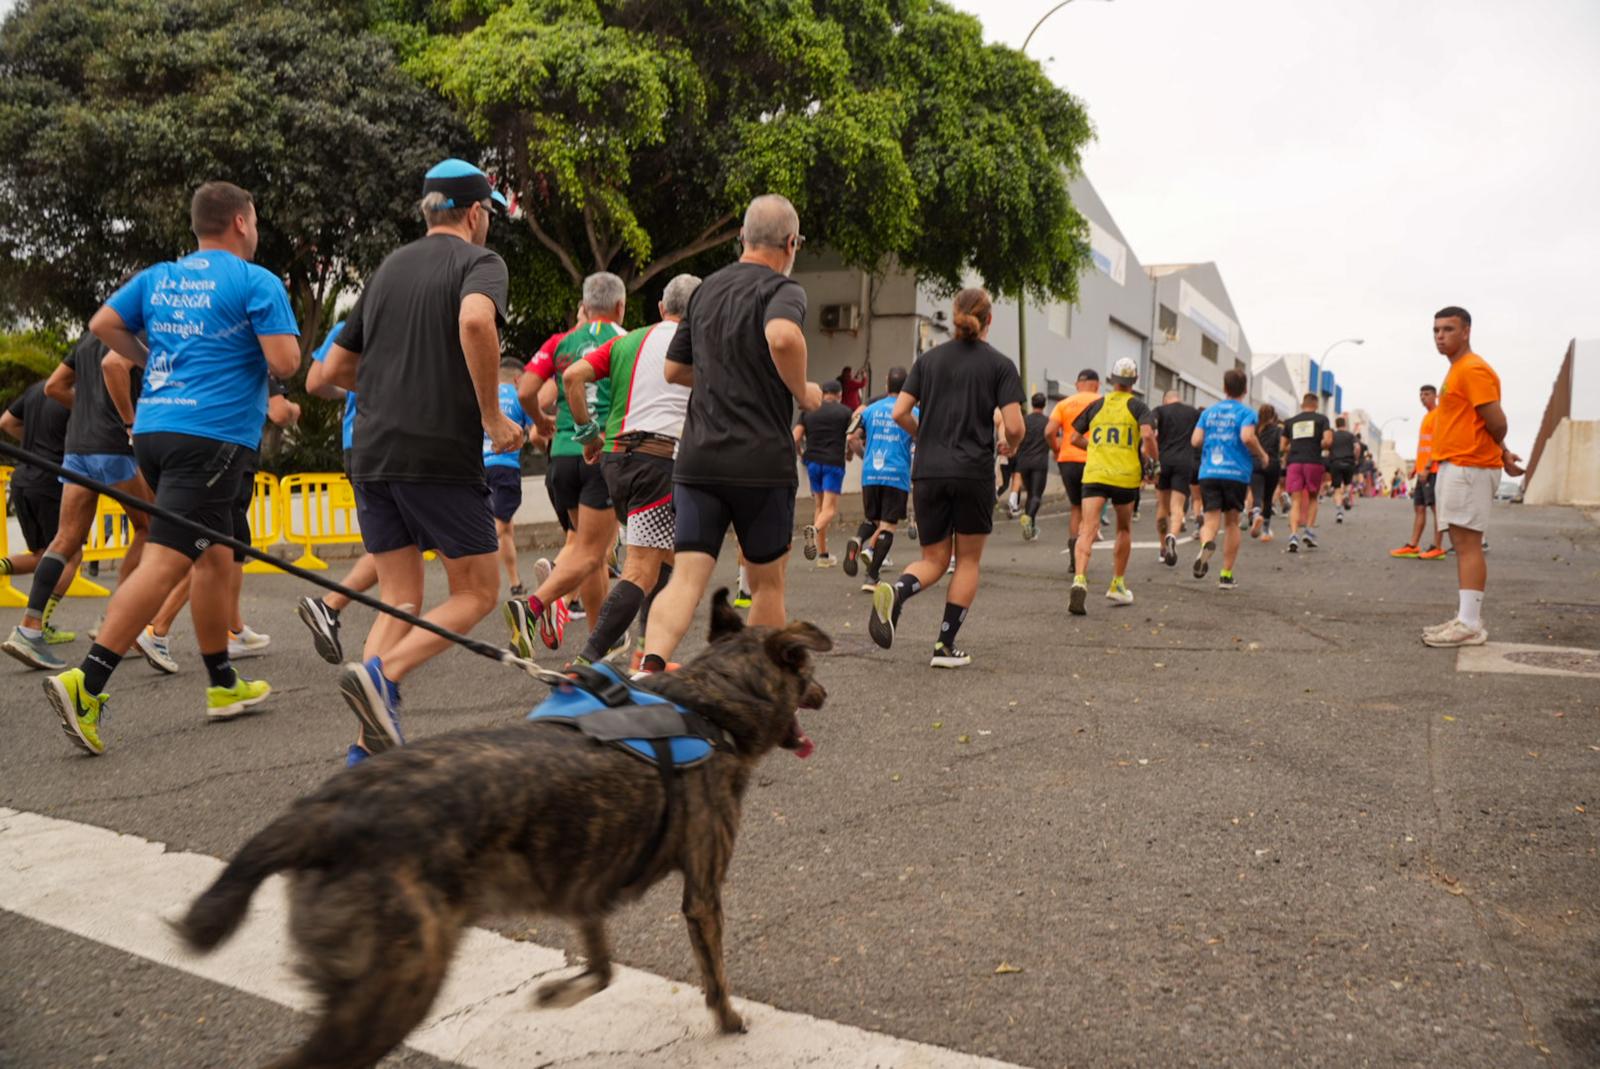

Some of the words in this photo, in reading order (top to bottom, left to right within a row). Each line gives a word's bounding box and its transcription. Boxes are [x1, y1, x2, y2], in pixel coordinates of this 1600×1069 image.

[179, 275, 216, 292] buena
[151, 292, 212, 309] ENERGÍA
[172, 309, 185, 320] se
[152, 320, 204, 339] contagia!
